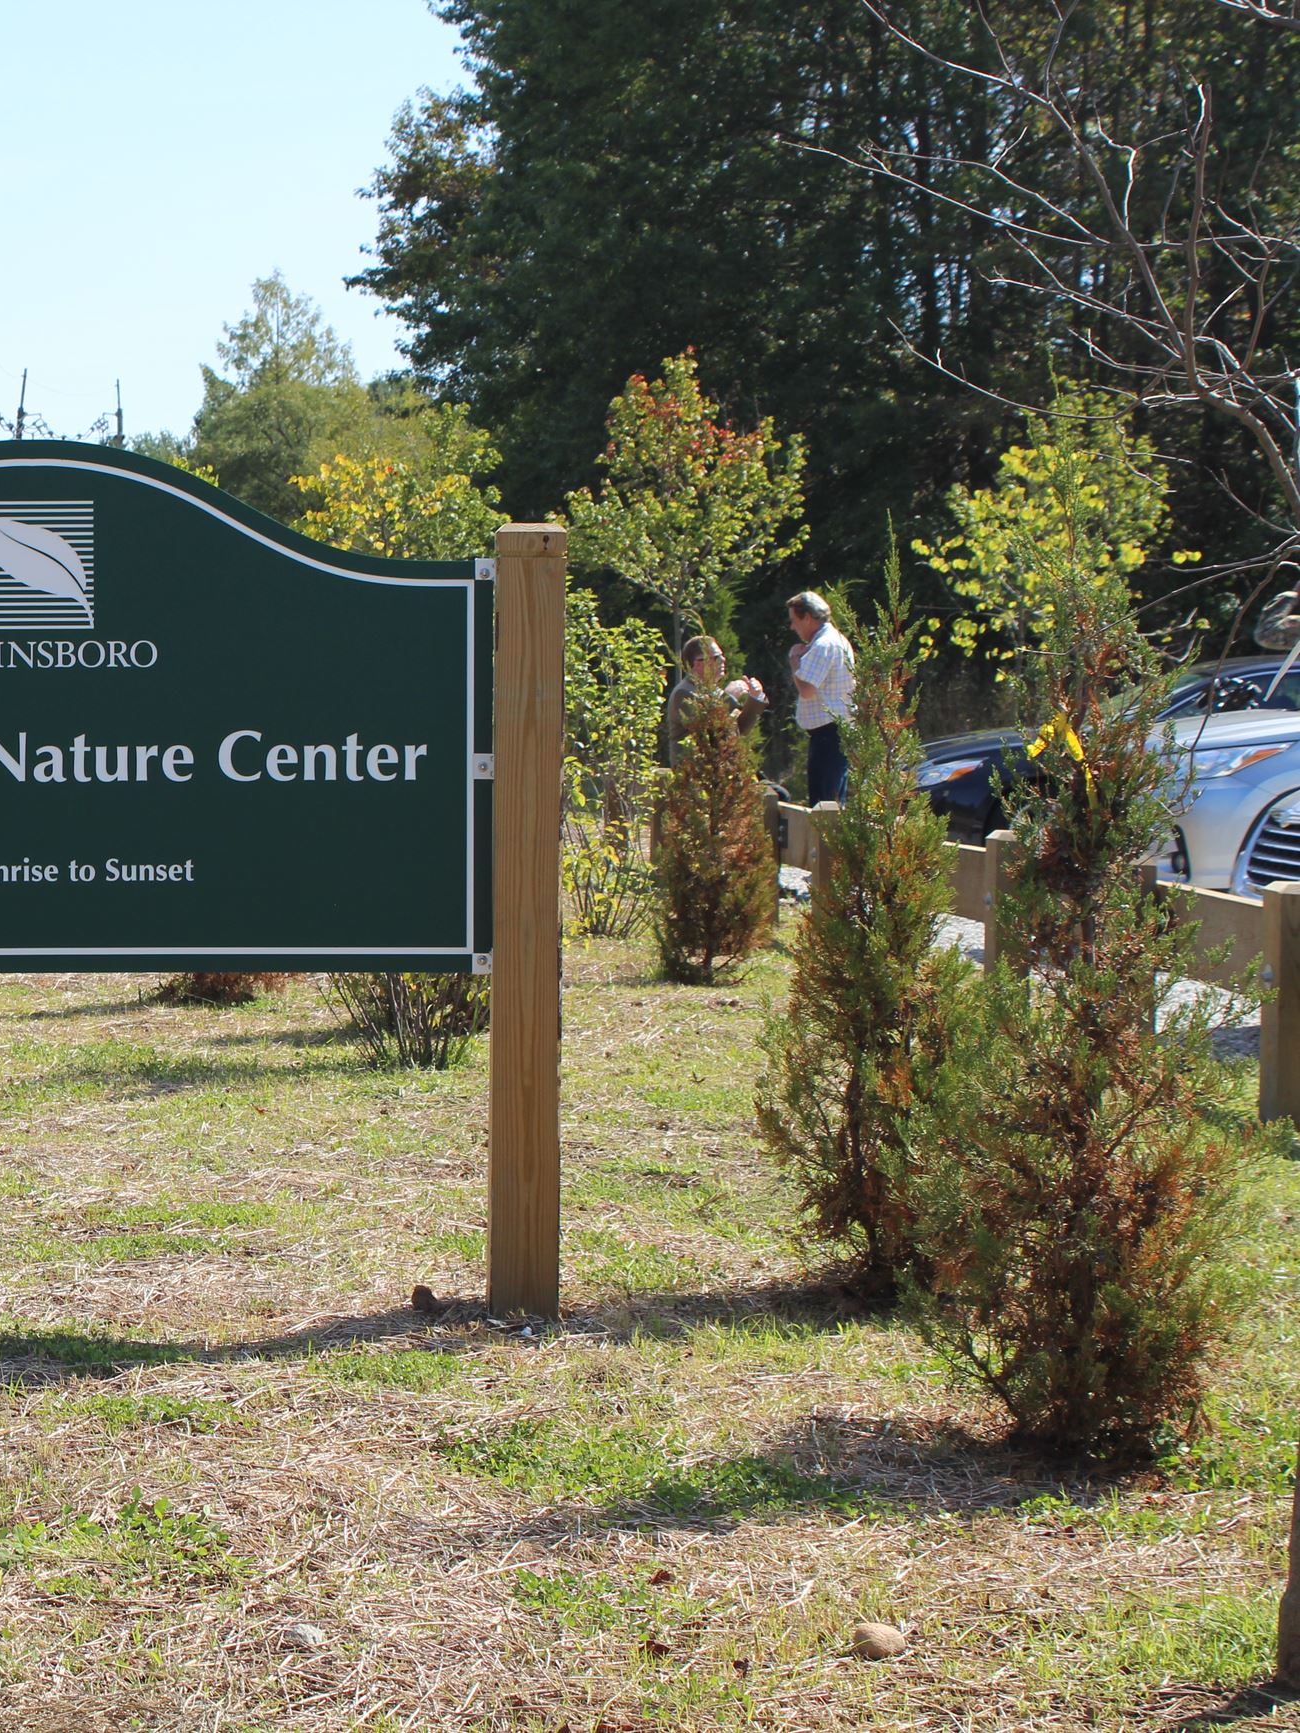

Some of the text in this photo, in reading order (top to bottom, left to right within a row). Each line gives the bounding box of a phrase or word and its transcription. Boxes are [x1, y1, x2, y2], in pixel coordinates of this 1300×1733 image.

[219, 730, 428, 782] Center
[69, 860, 96, 882] to
[105, 859, 194, 882] Sunset
